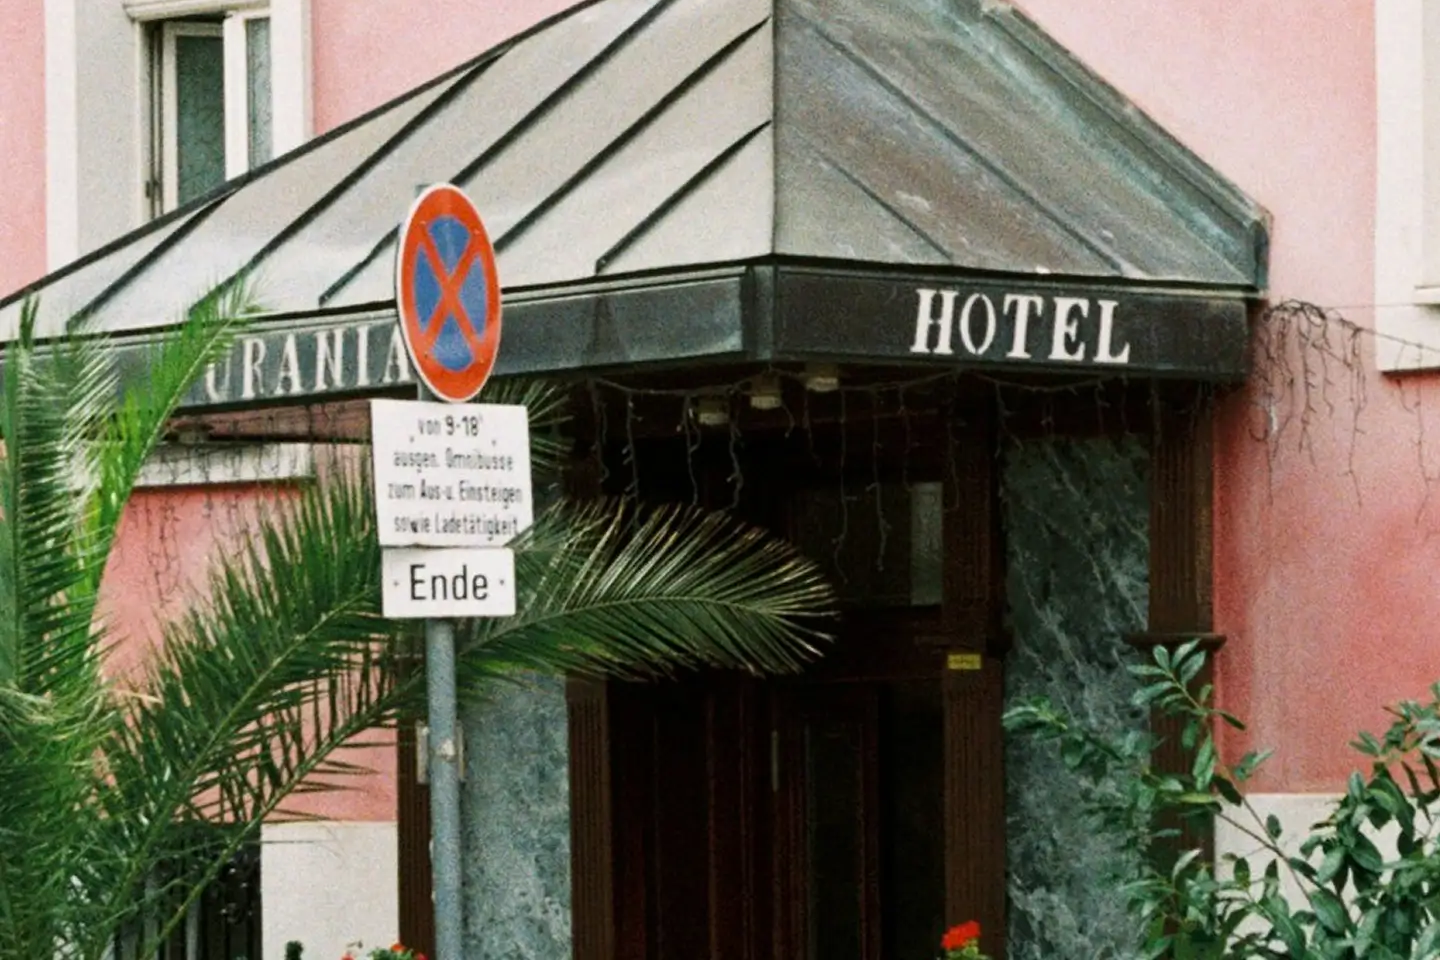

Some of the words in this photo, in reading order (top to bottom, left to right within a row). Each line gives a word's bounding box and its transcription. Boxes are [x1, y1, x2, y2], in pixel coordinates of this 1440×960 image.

[910, 289, 1131, 364] HOTEL
[204, 324, 412, 402] URANIA
[417, 419, 442, 436] von
[445, 447, 514, 471] Omnibusse
[388, 482, 416, 500] zum
[459, 479, 524, 510] Einsteigen
[394, 513, 431, 534] sowie
[435, 513, 520, 541] Ladetätigkeit
[409, 563, 489, 601] Ende
